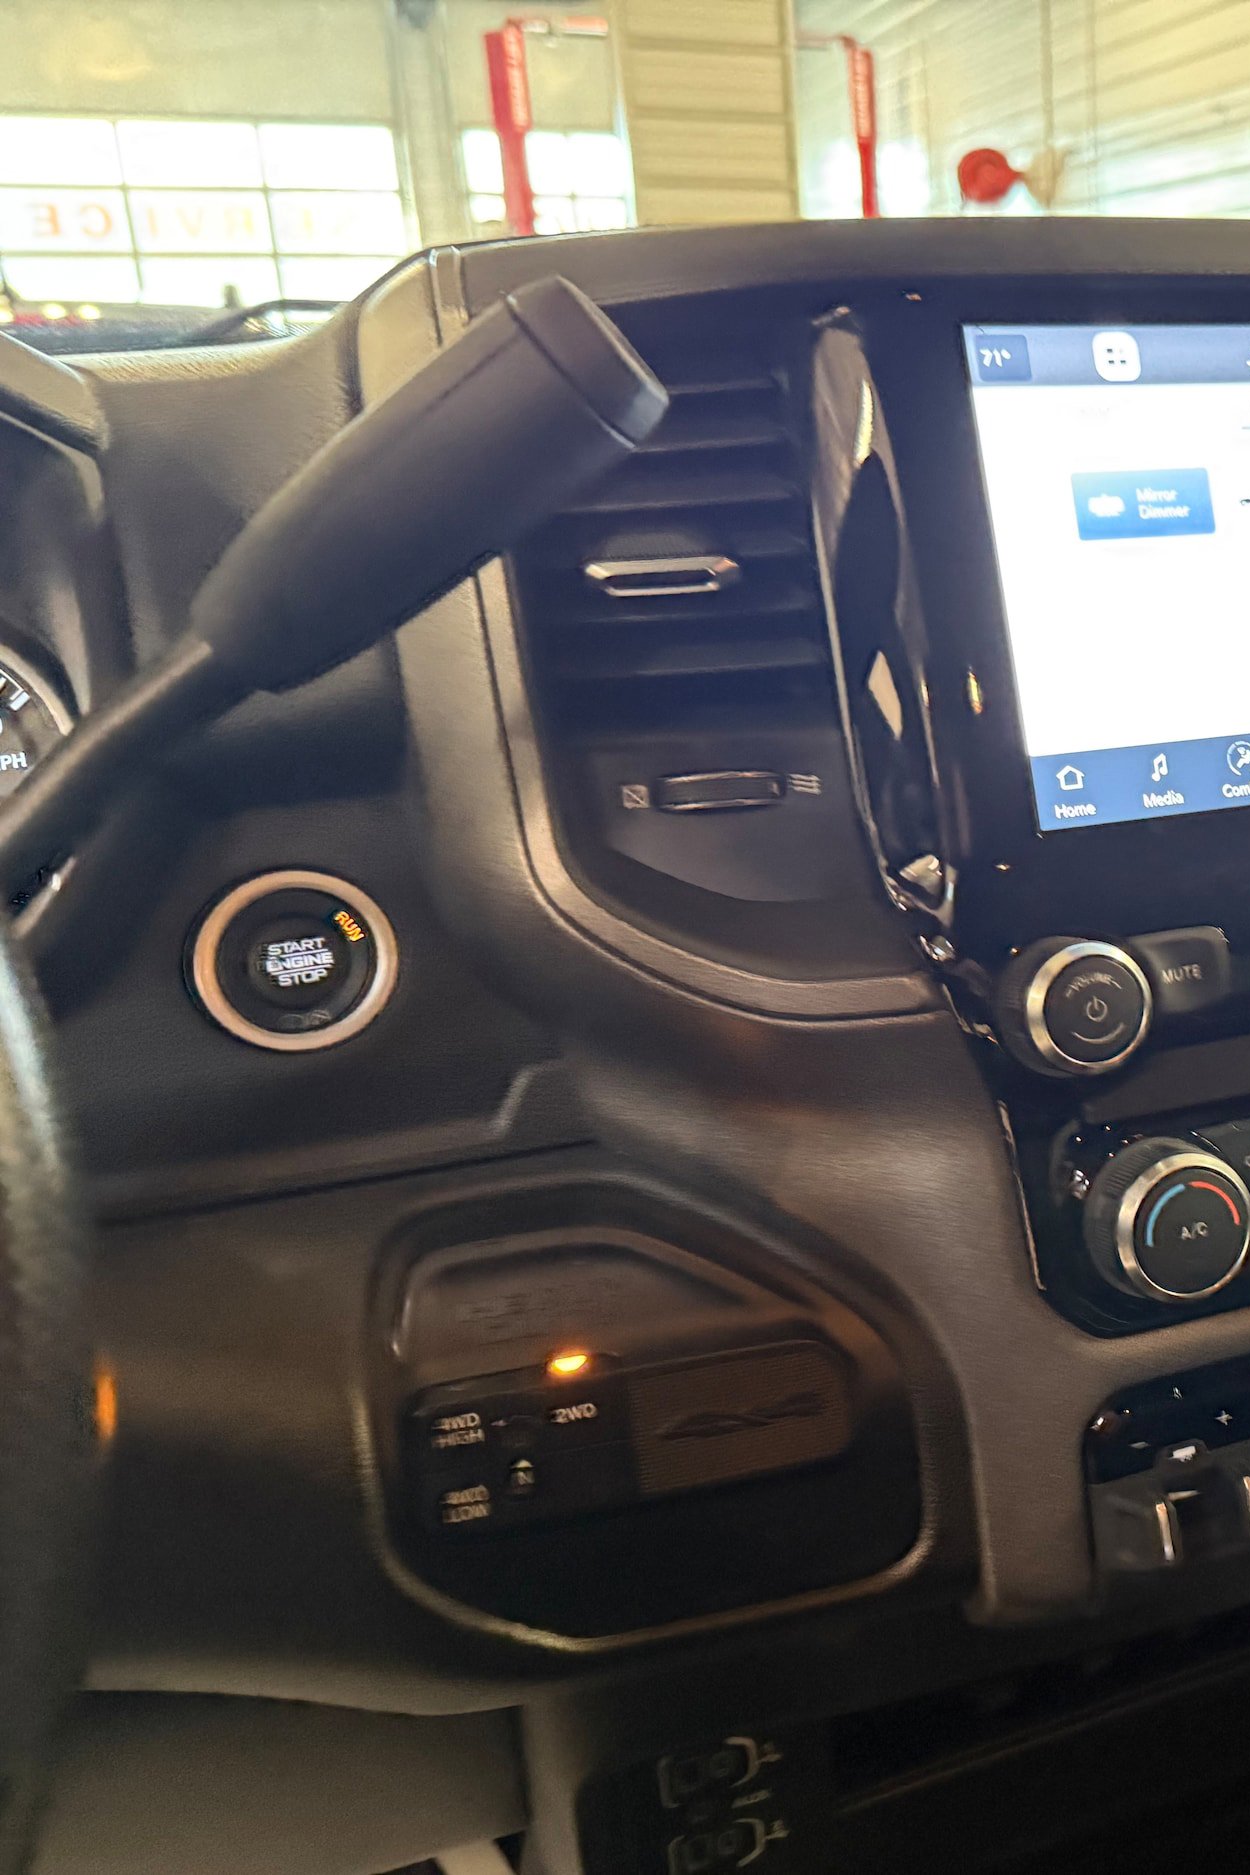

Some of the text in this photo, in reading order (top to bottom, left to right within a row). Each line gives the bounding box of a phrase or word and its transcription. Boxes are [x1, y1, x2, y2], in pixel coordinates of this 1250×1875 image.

[1136, 488, 1178, 503] Mirror
[1138, 504, 1191, 519] Dimmer
[0, 752, 28, 771] PH
[1142, 789, 1185, 809] Media
[1054, 802, 1097, 820] Home
[335, 911, 365, 942] RUN
[268, 937, 326, 956] START
[265, 951, 335, 973] ENGINE
[278, 968, 328, 987] STOP
[1160, 963, 1202, 985] MUTE
[550, 1402, 599, 1425] 2WD
